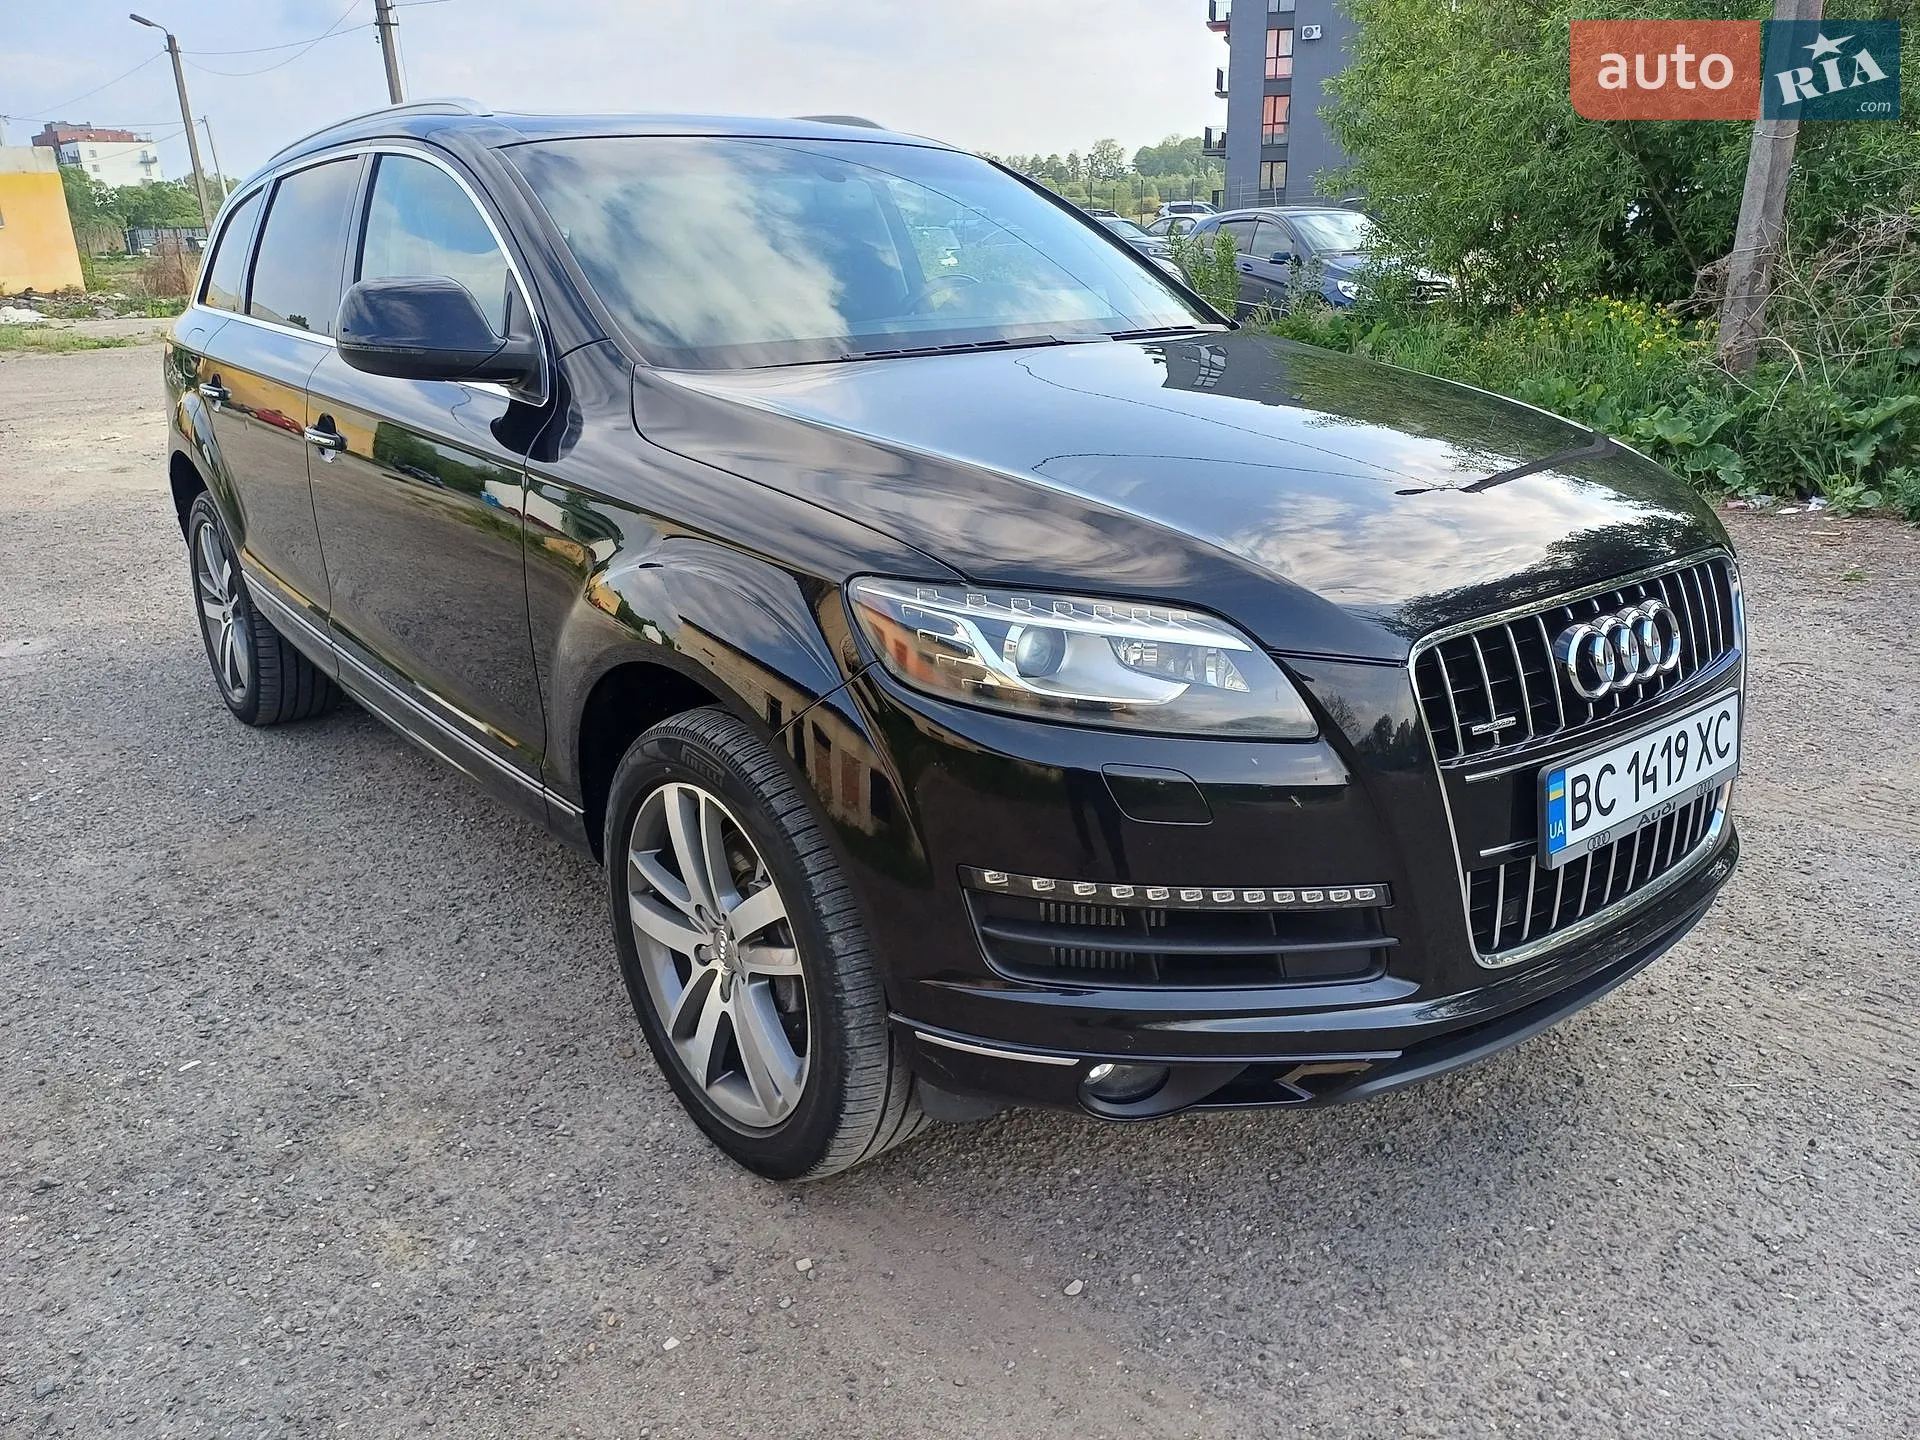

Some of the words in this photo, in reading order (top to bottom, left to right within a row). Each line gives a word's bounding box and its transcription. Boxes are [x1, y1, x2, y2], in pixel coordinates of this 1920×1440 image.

[1571, 764, 1616, 831] BC
[1627, 730, 1688, 803] 1419
[1696, 710, 1731, 772] XC
[1636, 802, 1676, 828] Audi
[1549, 823, 1564, 839] UA
